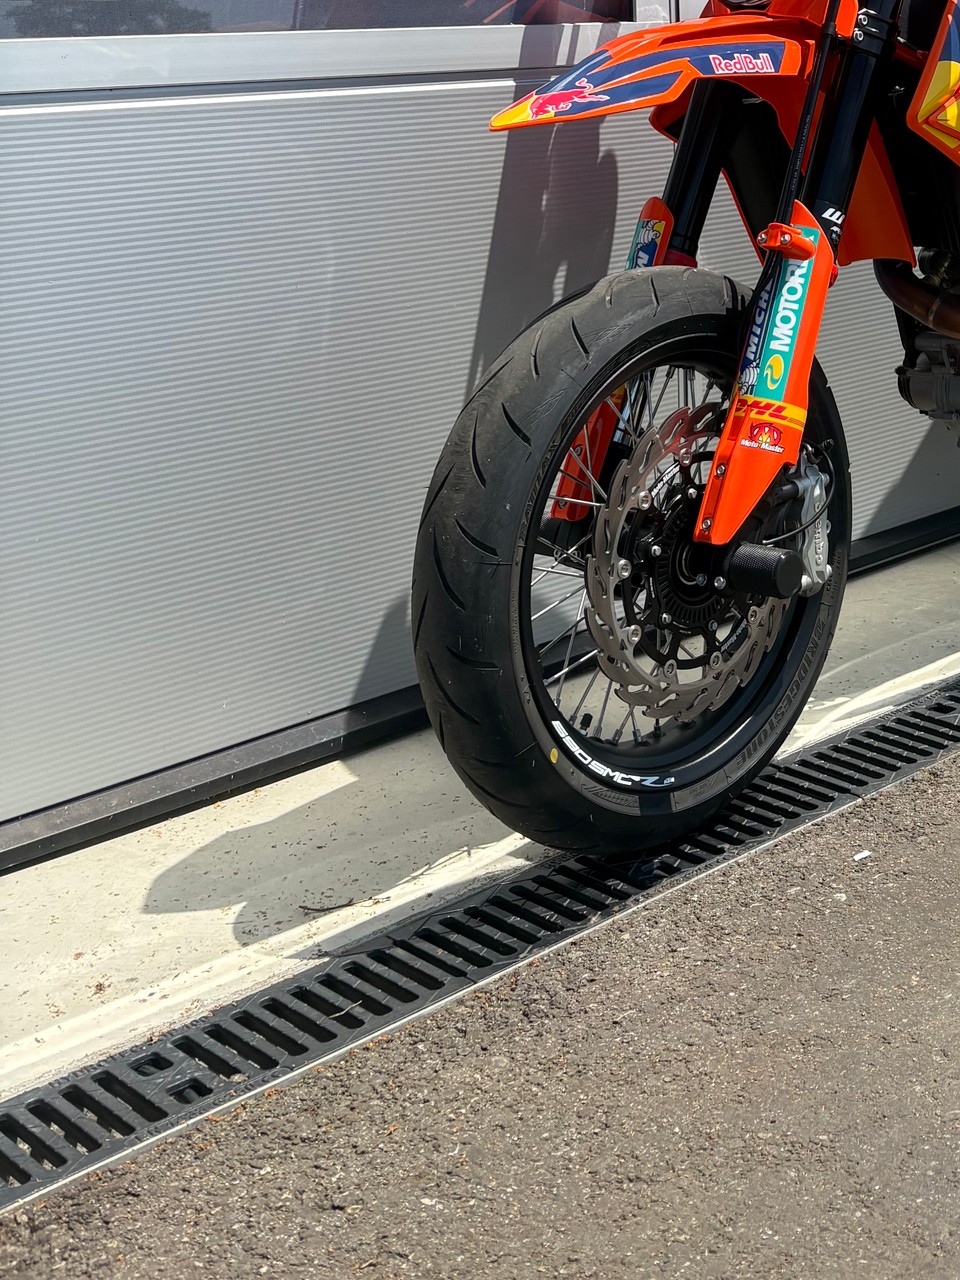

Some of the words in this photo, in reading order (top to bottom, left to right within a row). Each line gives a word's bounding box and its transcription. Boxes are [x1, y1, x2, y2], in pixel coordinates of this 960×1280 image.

[769, 236, 814, 353] MOTOR
[735, 399, 788, 420] DHL
[814, 502, 825, 567] bembo
[736, 617, 826, 770] BRIDGESTONE
